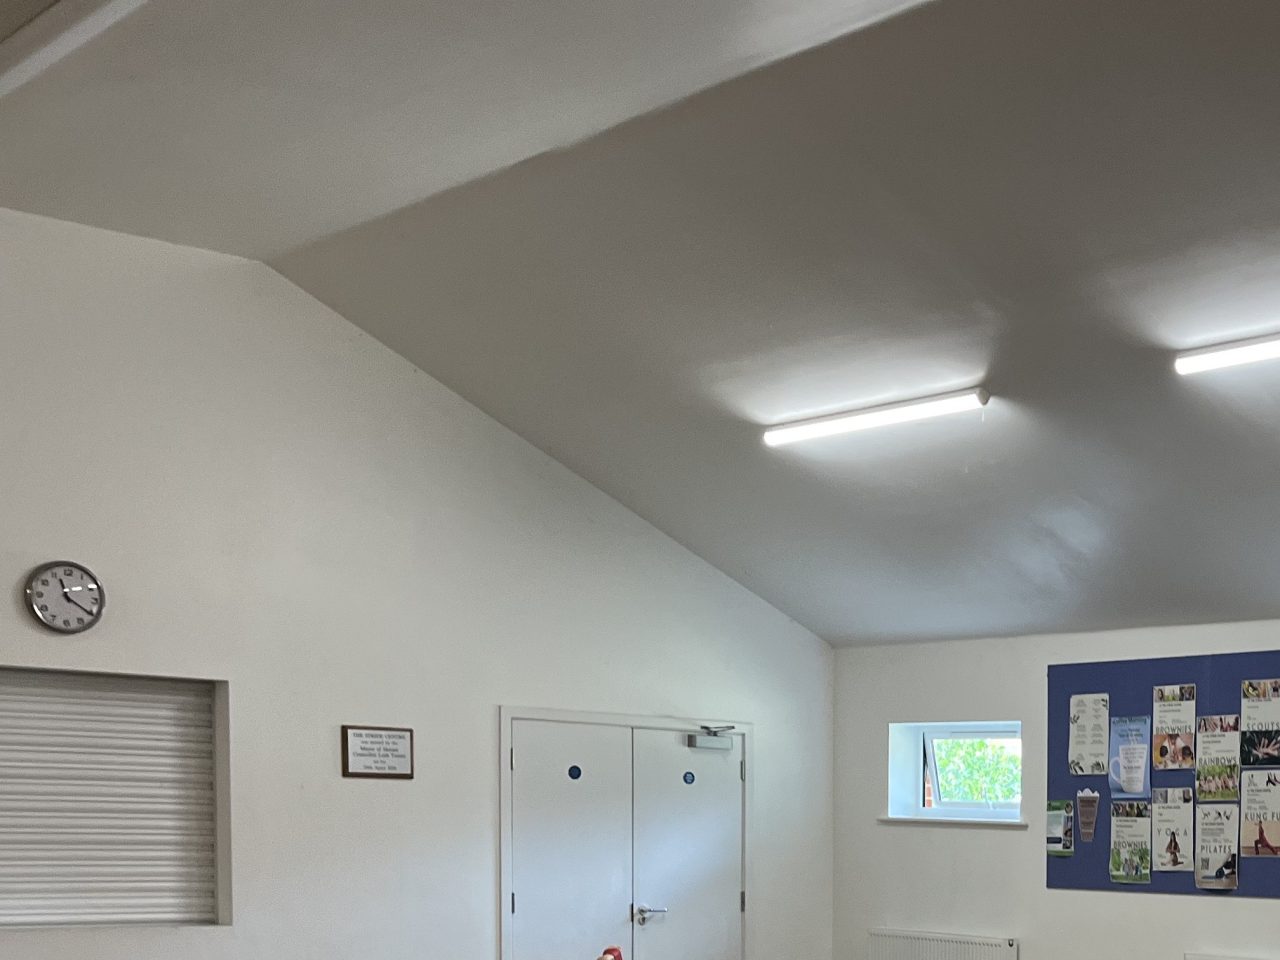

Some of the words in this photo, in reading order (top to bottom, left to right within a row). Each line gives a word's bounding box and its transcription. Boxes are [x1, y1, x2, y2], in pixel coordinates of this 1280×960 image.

[1155, 725, 1193, 735] BROWNIES
[1246, 721, 1280, 731] SCOUTS
[1198, 756, 1237, 768] RAINBOWS
[1244, 812, 1268, 822] KUNG
[1113, 840, 1148, 850] BROWNIES
[1200, 844, 1232, 854] PILATES
